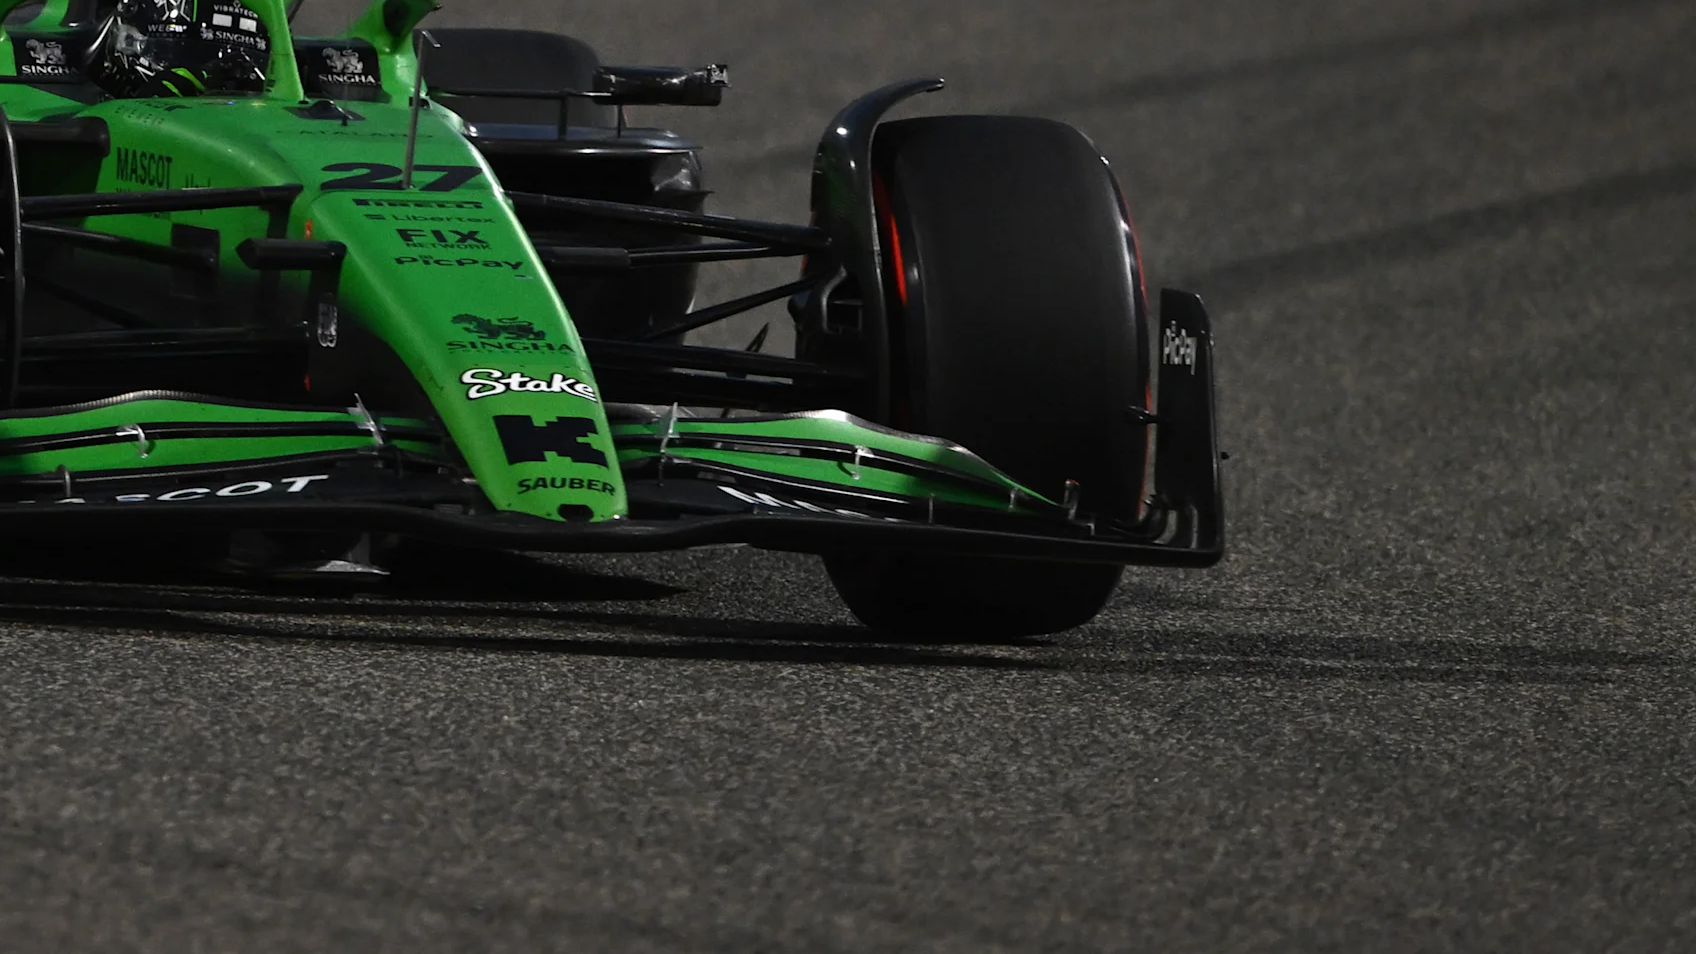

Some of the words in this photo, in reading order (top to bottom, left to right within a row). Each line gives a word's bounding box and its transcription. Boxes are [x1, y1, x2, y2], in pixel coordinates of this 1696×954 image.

[215, 30, 256, 45] SINGHA
[318, 73, 376, 84] SINGHA
[116, 147, 173, 190] MASCOT
[320, 162, 483, 192] 27
[396, 229, 489, 244] FIX
[394, 254, 523, 270] PicPay
[445, 340, 576, 354] SINGHA
[461, 367, 599, 403] Stake
[18, 474, 329, 504] SCOT
[517, 477, 616, 496] SAUBER
